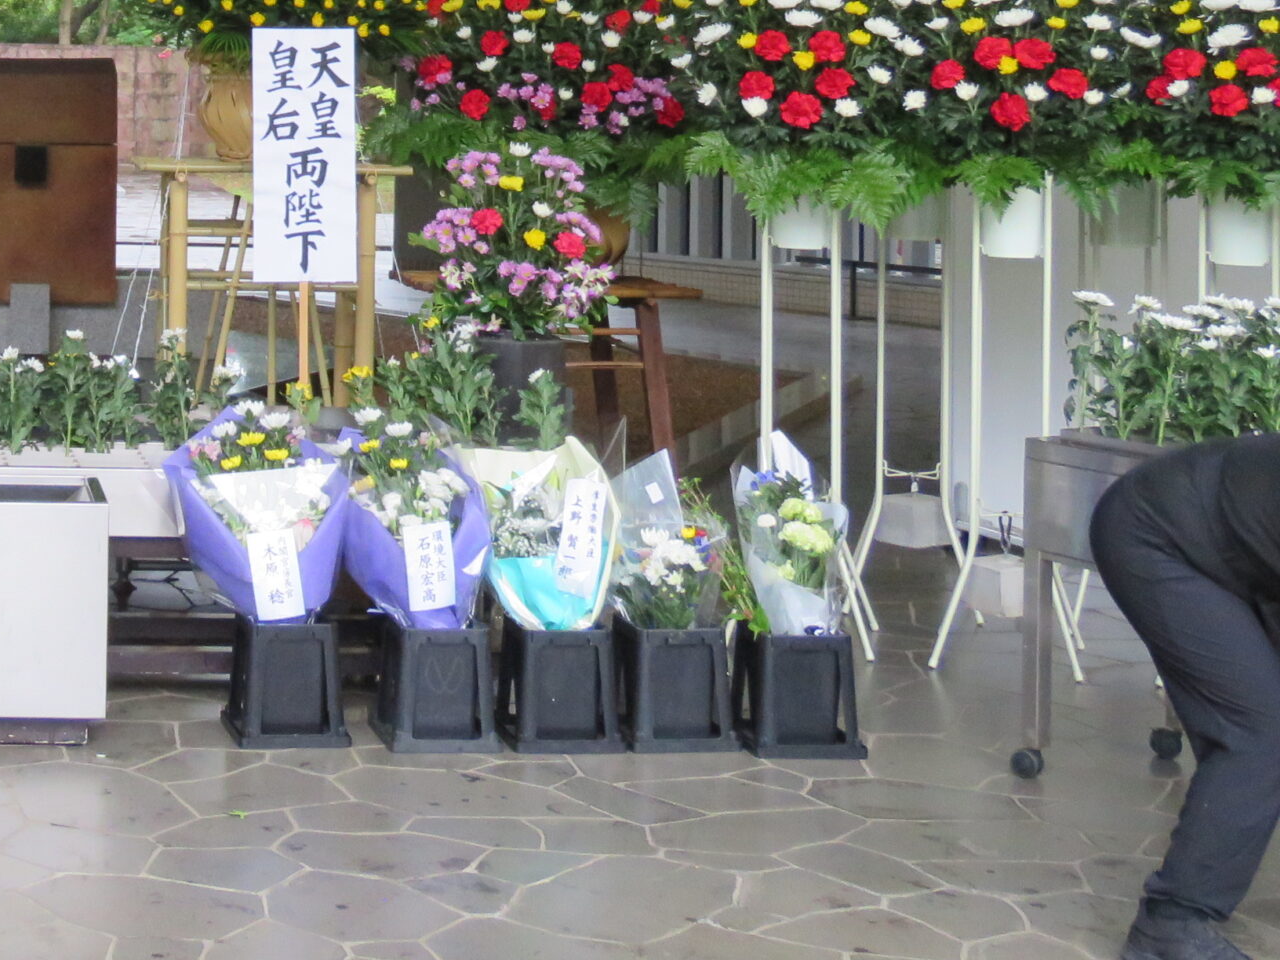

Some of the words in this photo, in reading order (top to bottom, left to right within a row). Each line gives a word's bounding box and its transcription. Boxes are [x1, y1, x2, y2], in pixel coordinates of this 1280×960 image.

[260, 39, 303, 142] 皇后
[306, 41, 350, 140] 天皇
[283, 146, 329, 274] 両陛下
[417, 536, 436, 603] 石原宏高
[432, 529, 448, 582] 環境大臣
